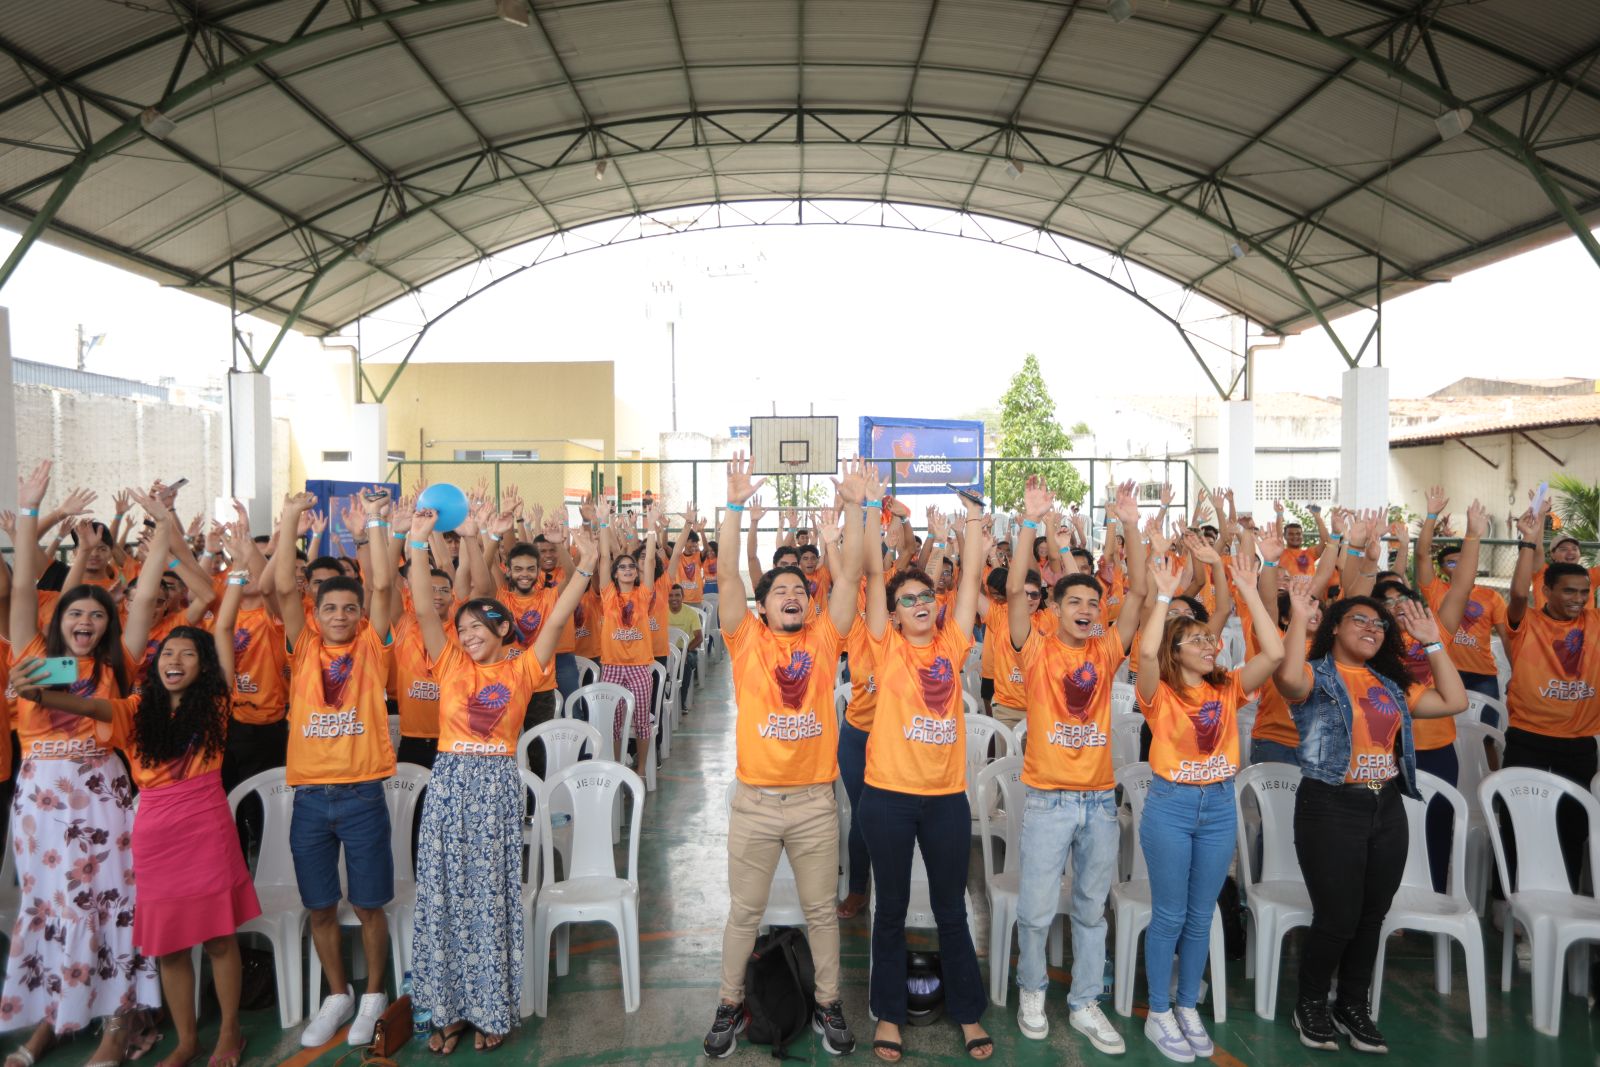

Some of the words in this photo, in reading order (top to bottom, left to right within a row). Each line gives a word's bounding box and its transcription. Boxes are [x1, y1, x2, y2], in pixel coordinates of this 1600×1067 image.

[912, 463, 952, 473] VALORES
[768, 708, 816, 729] CEARÁ
[757, 722, 823, 741] VALORES
[1054, 721, 1099, 737] CEARÁ
[550, 733, 580, 743] JESUS
[1046, 731, 1108, 750] VALORES
[453, 740, 508, 754] CEARÁ
[1169, 764, 1237, 783] VALORES
[575, 778, 613, 790] JESUS
[1261, 779, 1298, 792] JESUS
[1510, 786, 1550, 799] JESUS
